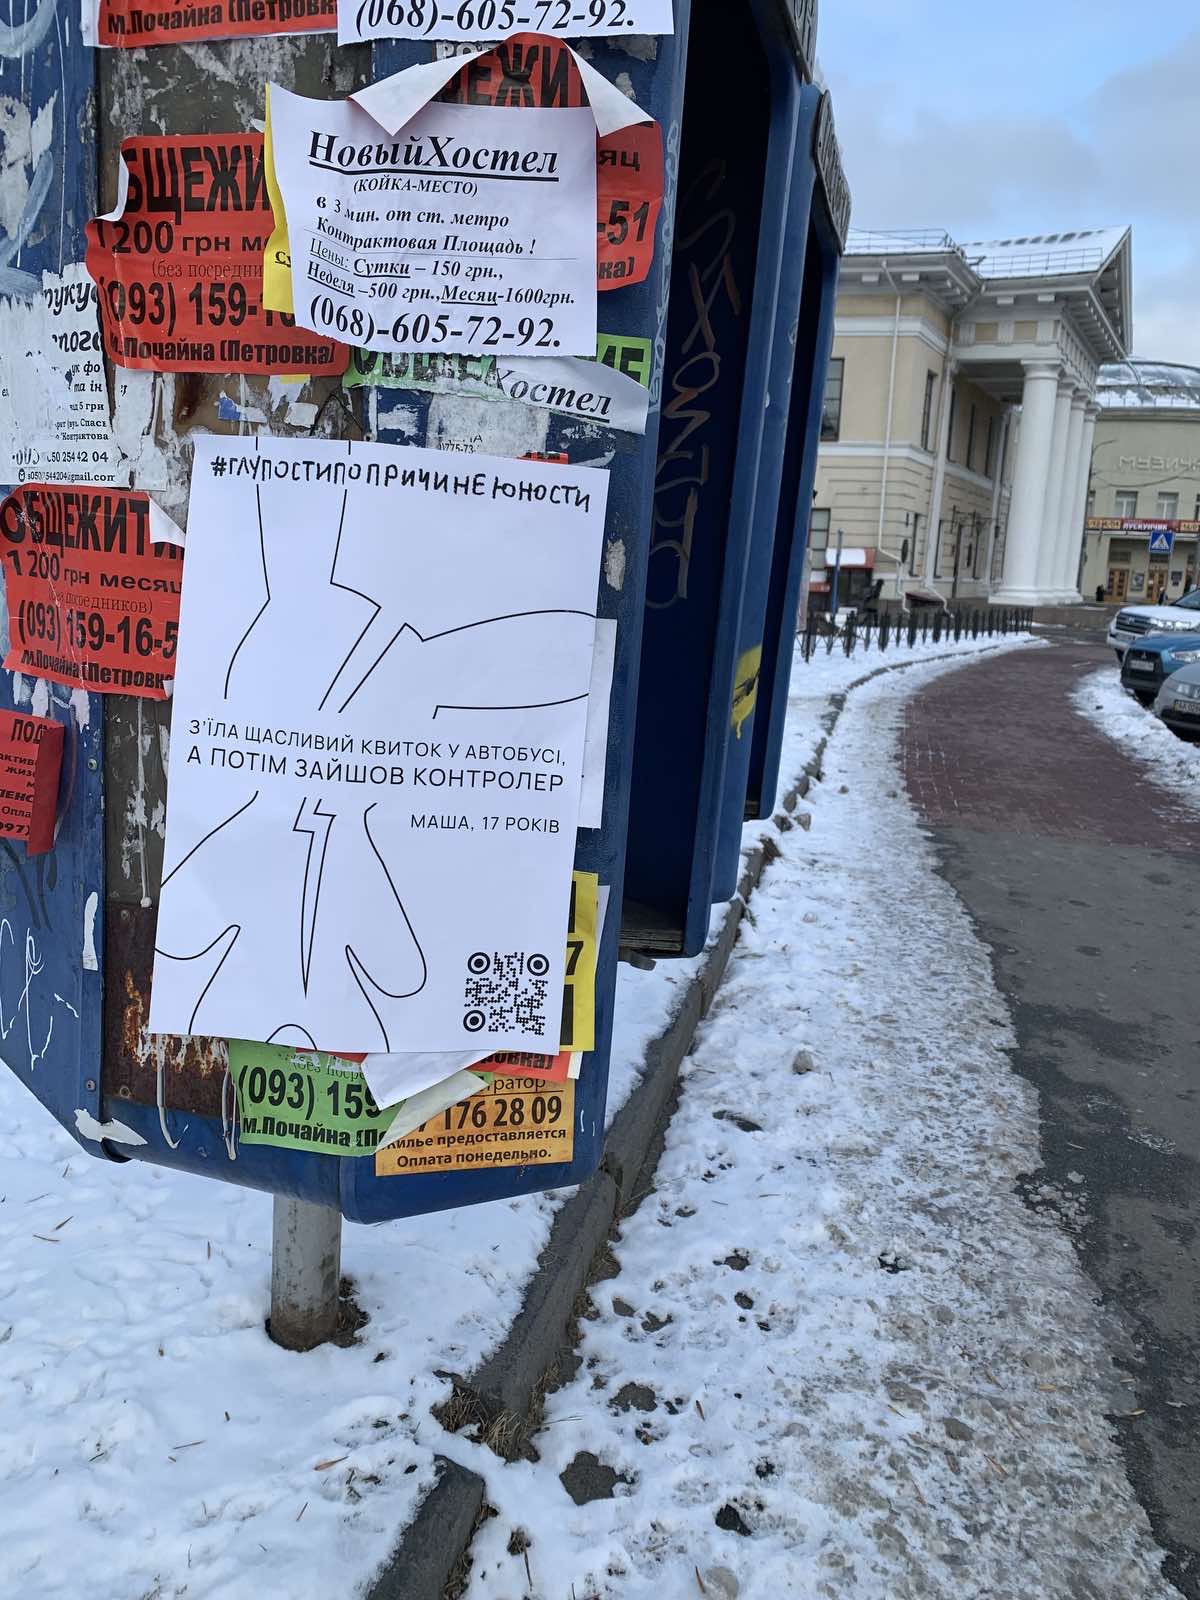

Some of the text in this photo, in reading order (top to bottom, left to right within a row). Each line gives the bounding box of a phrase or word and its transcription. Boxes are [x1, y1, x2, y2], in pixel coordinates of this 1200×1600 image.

[108, 2, 223, 34] м.Почайна
[356, 0, 635, 36] (068)-605-72-92.
[353, 174, 479, 197] (КОЙКА-МЕСТО)
[316, 196, 510, 231] в 3 мин. от ст. метро
[182, 236, 230, 256] грн
[316, 216, 438, 253] Контрактовая
[443, 235, 524, 257] Площадь
[152, 262, 183, 278] (без
[310, 238, 350, 269] Цены:
[353, 258, 411, 277] Сутки
[431, 260, 461, 277] 150
[465, 265, 504, 282] грн.,
[307, 261, 355, 295] Неделя
[98, 276, 177, 337] (093)
[310, 293, 561, 347] (068)-605-72-92.
[220, 339, 335, 367] (Петровка)
[92, 451, 109, 463] 04
[64, 568, 90, 587] грн
[18, 599, 61, 650] (093)
[245, 726, 354, 754] ЩАСЛИВИЙ
[361, 739, 442, 758] КВИТОК
[448, 743, 460, 758] У
[465, 744, 566, 767] АВТОБУСІ,
[187, 745, 564, 793] А ПОТІМ ЗАЙШОВ КОНТРОЛЕР
[410, 814, 561, 833] МАША, 17 РОКІВ
[238, 1065, 315, 1120] (093)
[493, 1098, 525, 1127] 28
[532, 1095, 562, 1125] 09
[243, 1116, 350, 1147] м.Почайна
[438, 1128, 566, 1147] предоставляется
[397, 1147, 552, 1168] Оплата понедельно.
